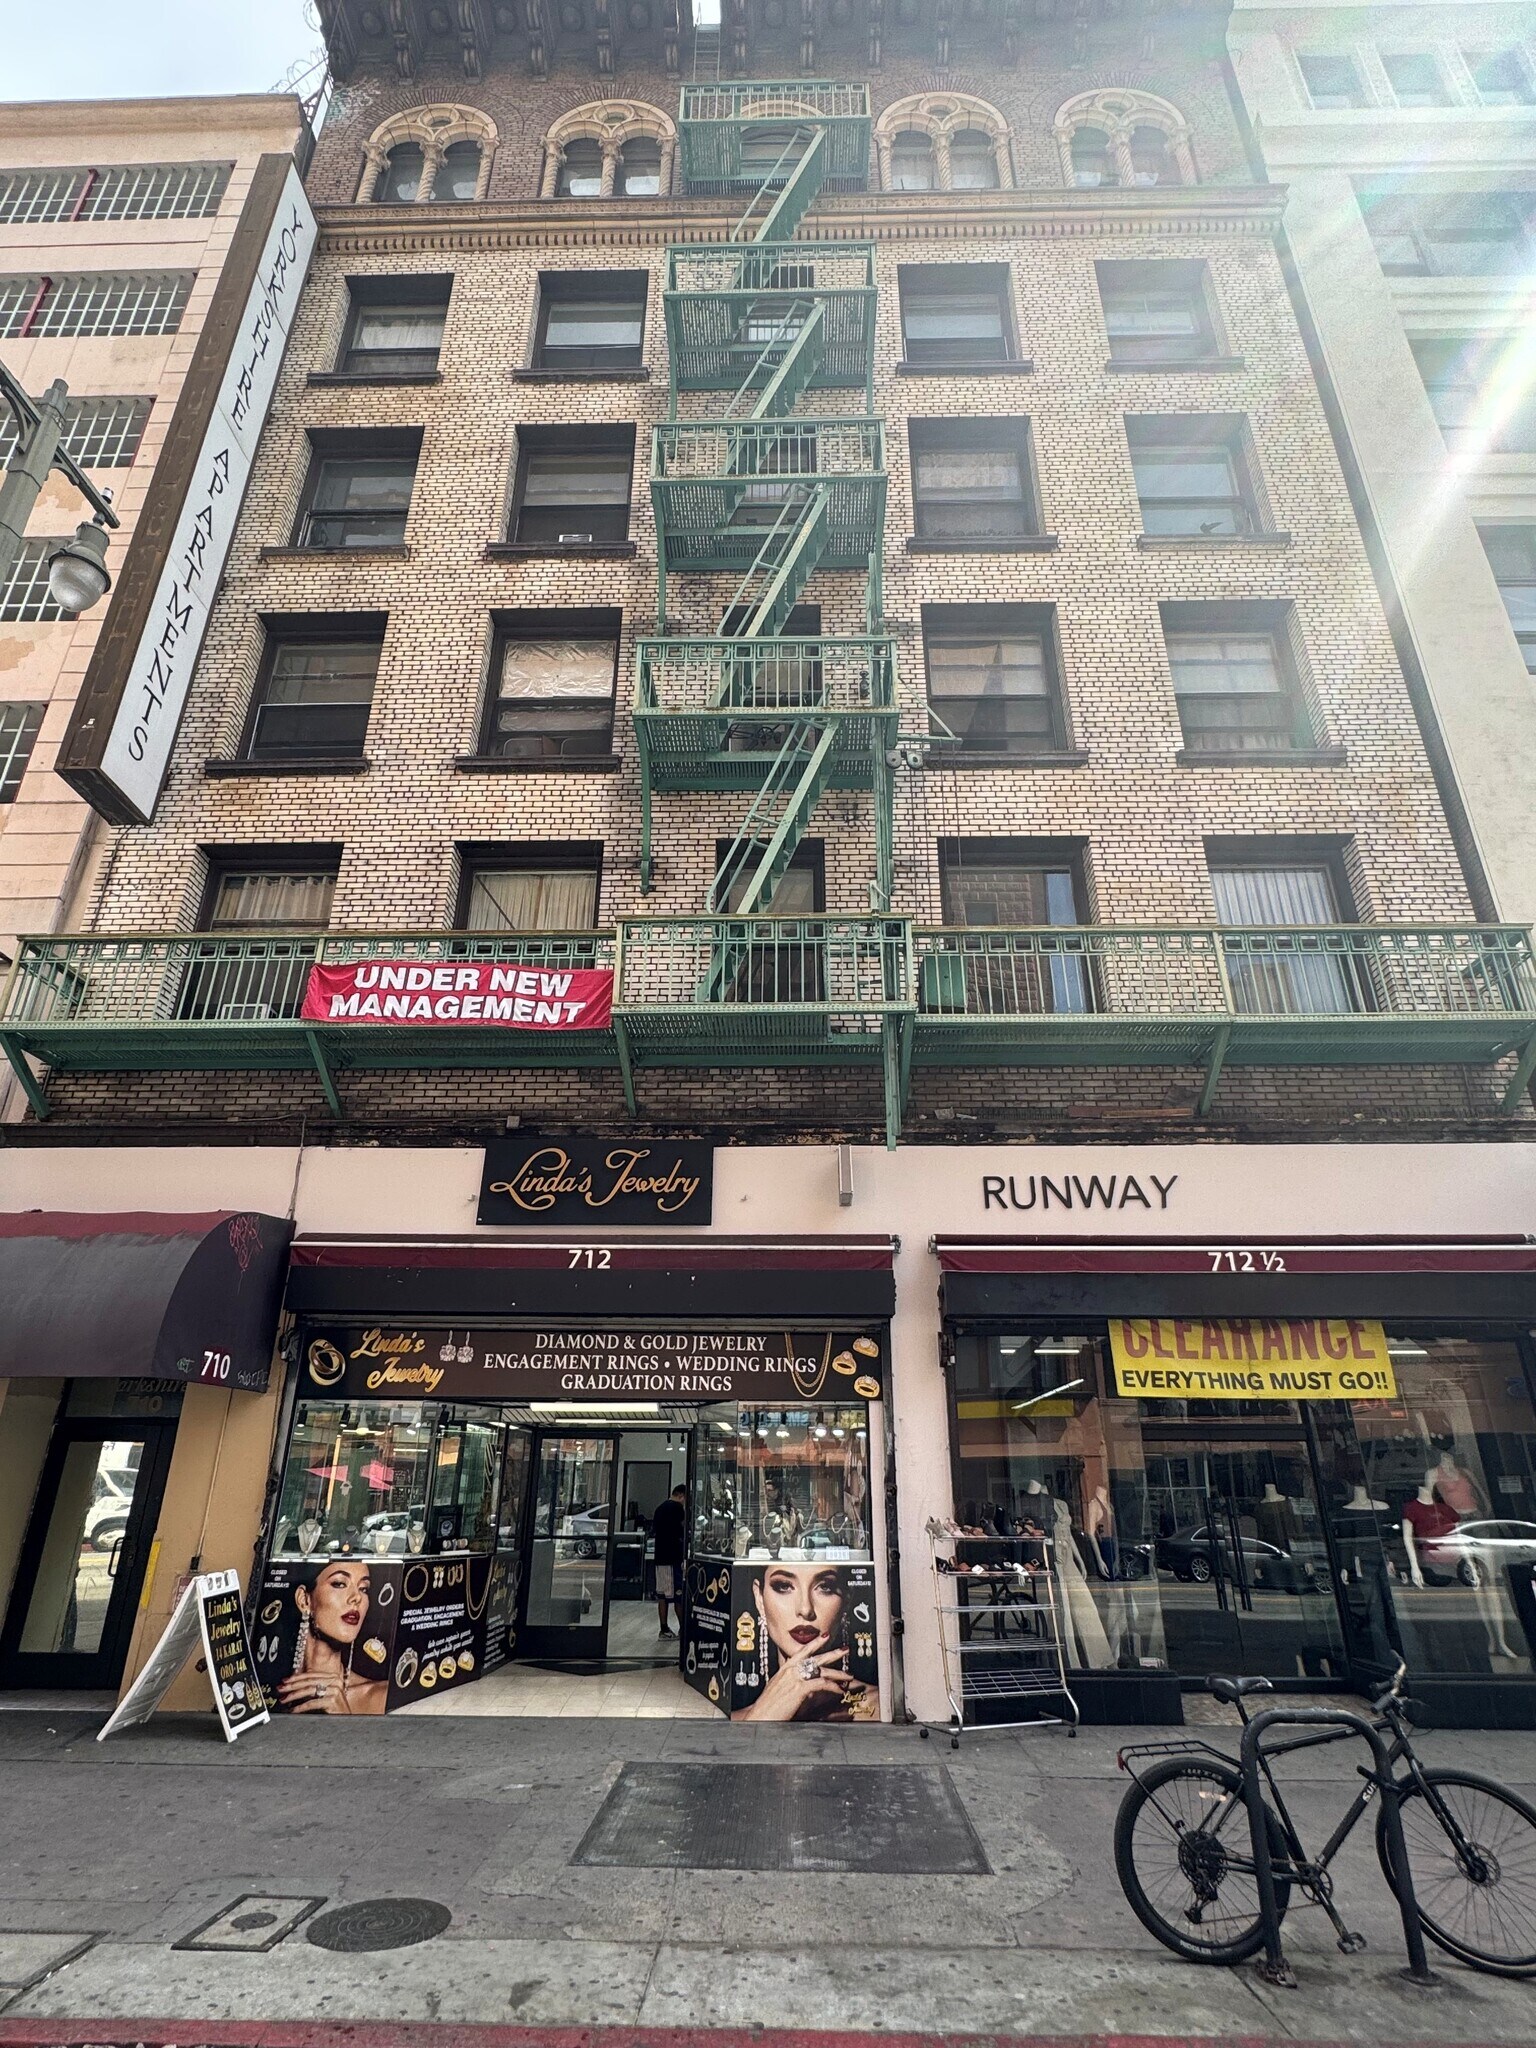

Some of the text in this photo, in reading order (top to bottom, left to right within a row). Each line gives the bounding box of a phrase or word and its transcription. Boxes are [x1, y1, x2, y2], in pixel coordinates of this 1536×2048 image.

[128, 203, 303, 762] YORKSHIRE APARTMENTS
[354, 965, 573, 998] UNDER NEW
[328, 993, 587, 1024] MANAGEMENT
[489, 1147, 700, 1212] Linda's Jewelry
[982, 1174, 1178, 1210] RUNWAY
[568, 1249, 611, 1269] 712
[1207, 1251, 1255, 1271] 712
[350, 1327, 425, 1359] Linda's
[534, 1333, 767, 1354] DIAMOND & GOLD JEWELRY
[200, 1350, 231, 1380] 710
[366, 1356, 445, 1393] Jewelry
[483, 1353, 817, 1373] ENGAGEMENT RINGS WEDDING RINGS
[561, 1373, 732, 1391] GRADUATION RINGS
[1122, 1369, 1389, 1391] EVERYTHING MUST GO!!
[207, 1595, 238, 1619] Linda's
[210, 1617, 241, 1641] Jewelry
[222, 1639, 243, 1660] KARAT
